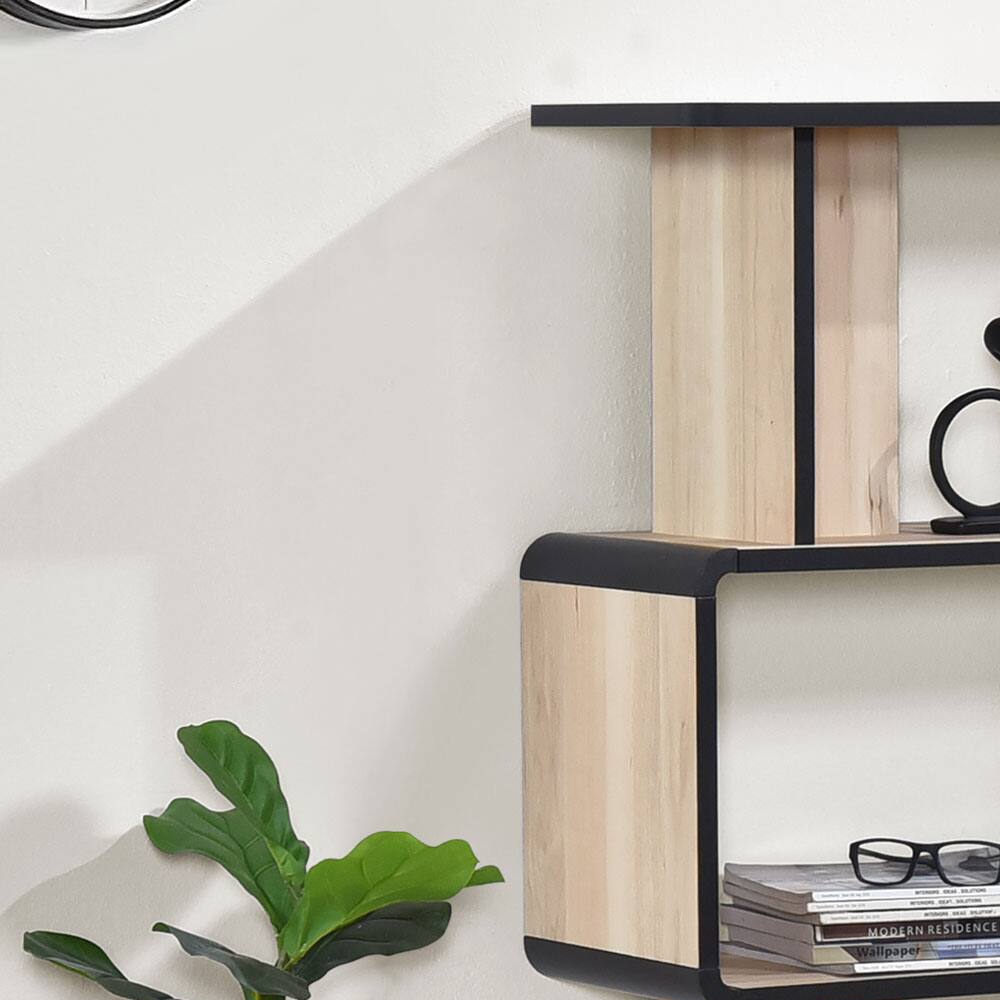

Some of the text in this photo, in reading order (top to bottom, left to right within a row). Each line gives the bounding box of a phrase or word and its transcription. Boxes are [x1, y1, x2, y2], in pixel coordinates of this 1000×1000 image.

[868, 926, 924, 938] MODERN
[928, 922, 997, 935] RESIDENCE
[857, 946, 920, 959] Wallpaper
